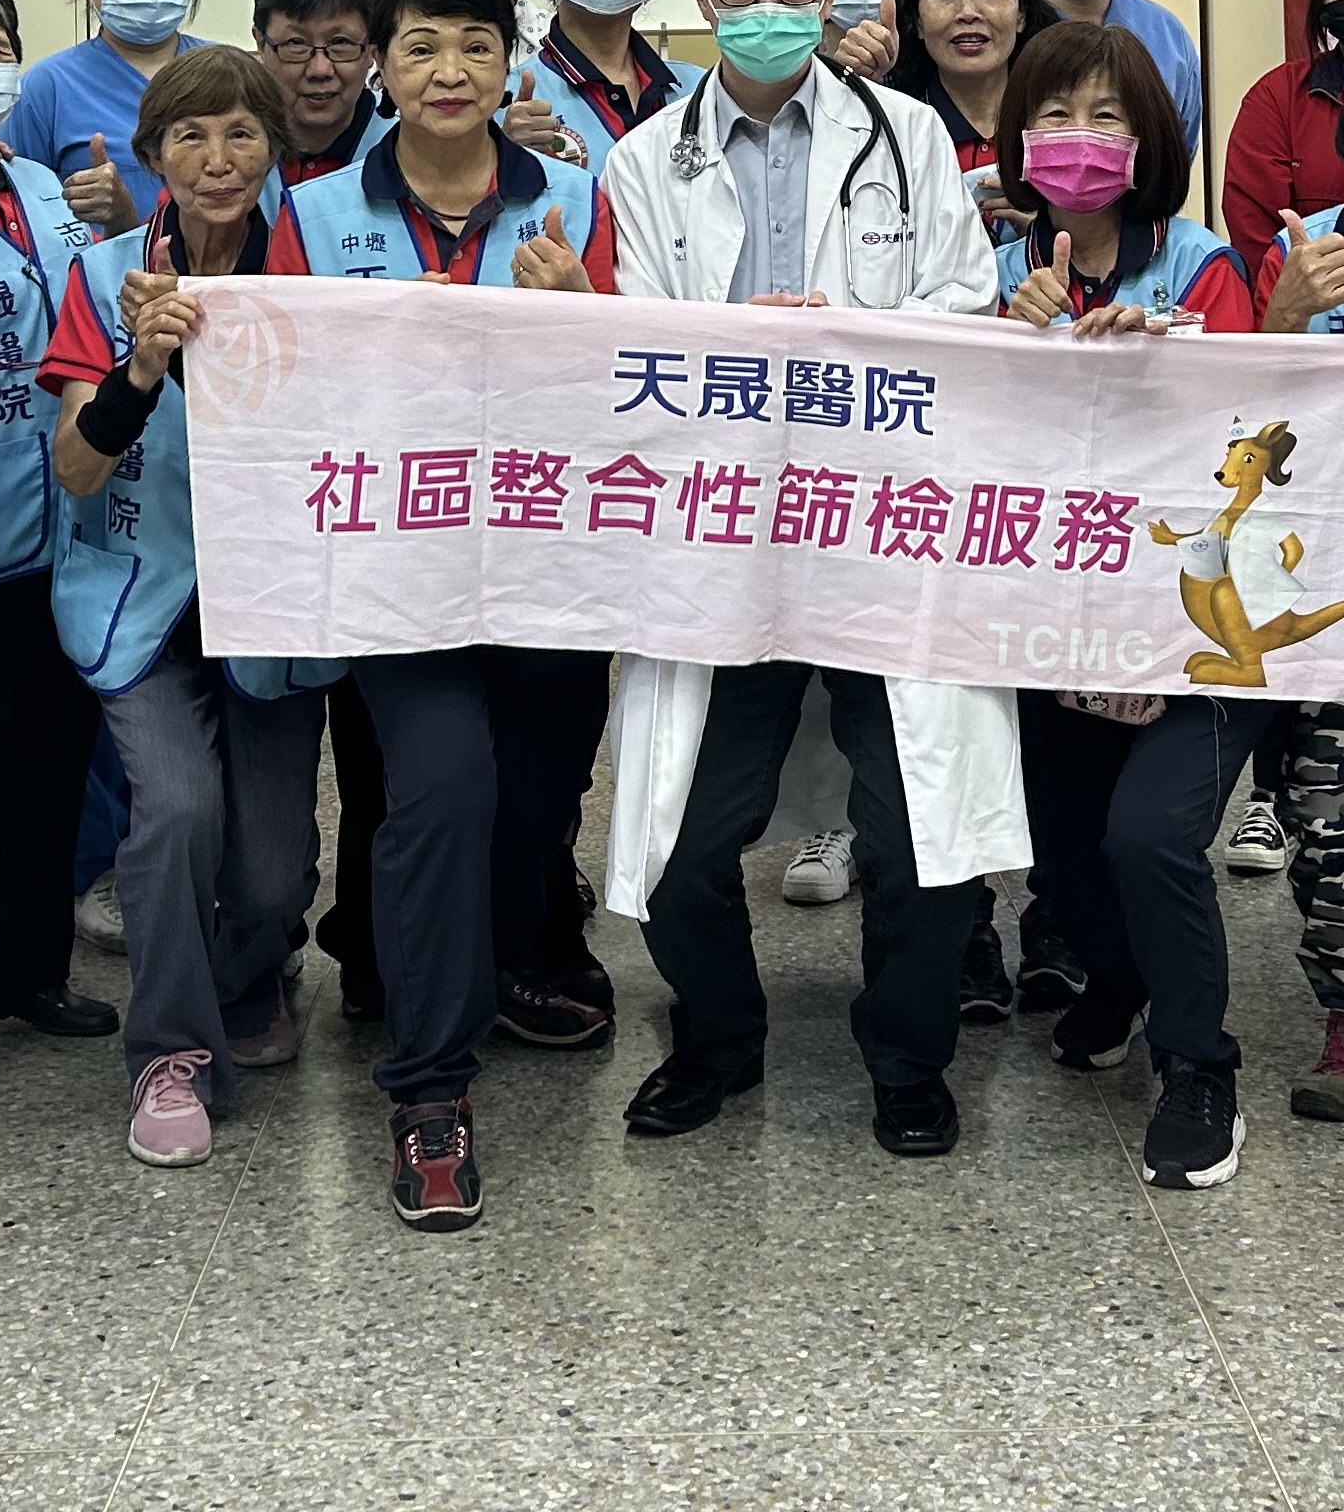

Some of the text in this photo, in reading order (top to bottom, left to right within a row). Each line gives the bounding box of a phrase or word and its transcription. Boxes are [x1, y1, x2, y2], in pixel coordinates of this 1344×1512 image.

[613, 349, 936, 436] 天晟醫院
[304, 447, 1142, 574] 社區整合性篩檢服務
[987, 620, 1156, 674] TCMG
